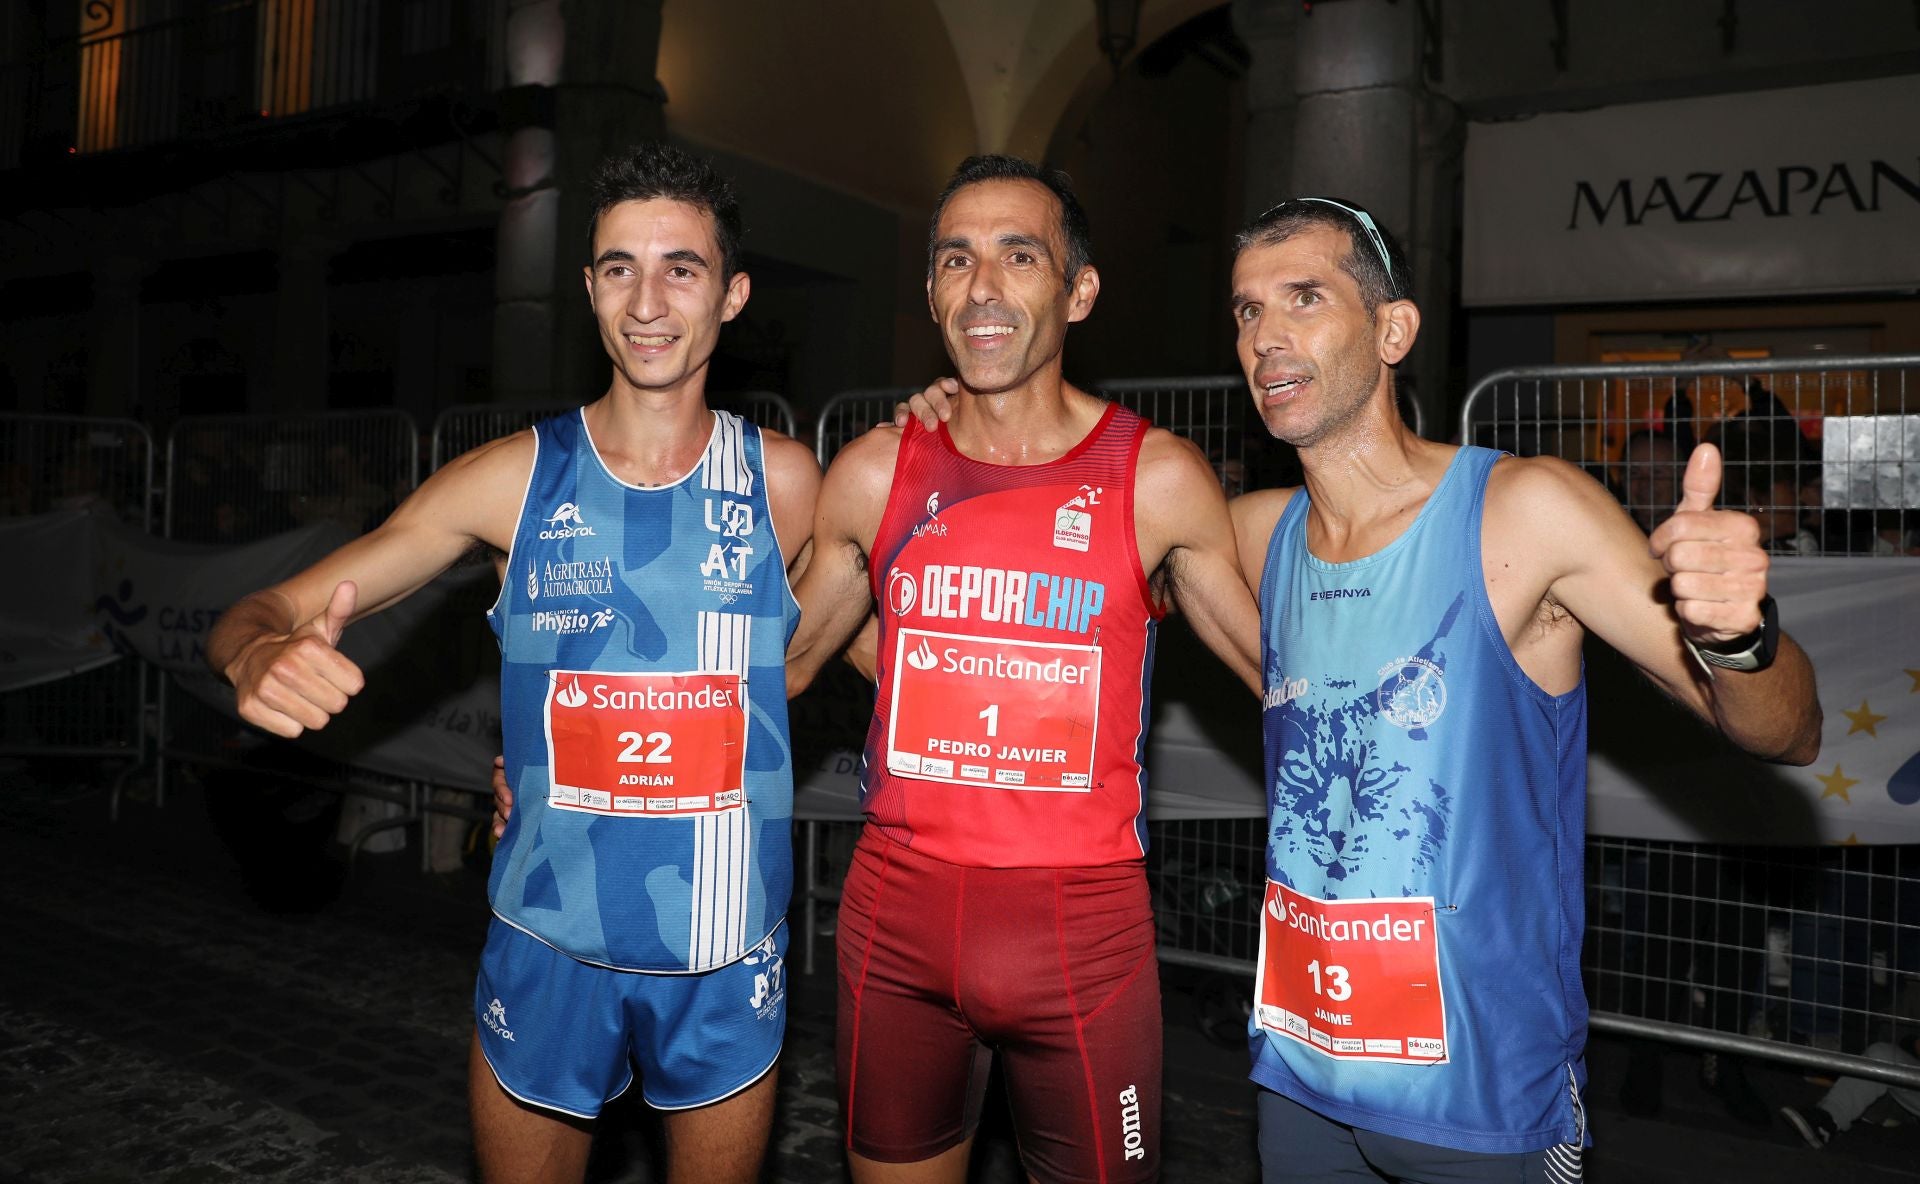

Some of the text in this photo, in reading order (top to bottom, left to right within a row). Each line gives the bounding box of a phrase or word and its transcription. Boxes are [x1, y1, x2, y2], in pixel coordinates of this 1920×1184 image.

[1567, 156, 1920, 231] MAZAPAN
[912, 523, 947, 538] AIMAR
[1055, 529, 1089, 541] ILDEFONSO
[543, 556, 612, 581] AGRITRASA
[543, 579, 613, 598] AUTOAGRICOLA
[921, 564, 1105, 634] DEPORCHIP
[1310, 587, 1371, 601] EVERNYA
[532, 612, 589, 635] iPhysio
[942, 647, 1091, 685] Santander
[592, 684, 733, 710] Santander
[1263, 676, 1309, 712] olaCao
[978, 704, 999, 737] 1
[616, 731, 673, 764] 22
[927, 737, 1067, 764] PEDRO JAVIER
[618, 774, 674, 786] ADRIÁN
[1288, 901, 1426, 942] Santander
[1307, 959, 1352, 1002] 13
[1314, 1006, 1353, 1026] JAIME
[1408, 1039, 1442, 1050] BOLADO
[1119, 1084, 1145, 1161] joma
